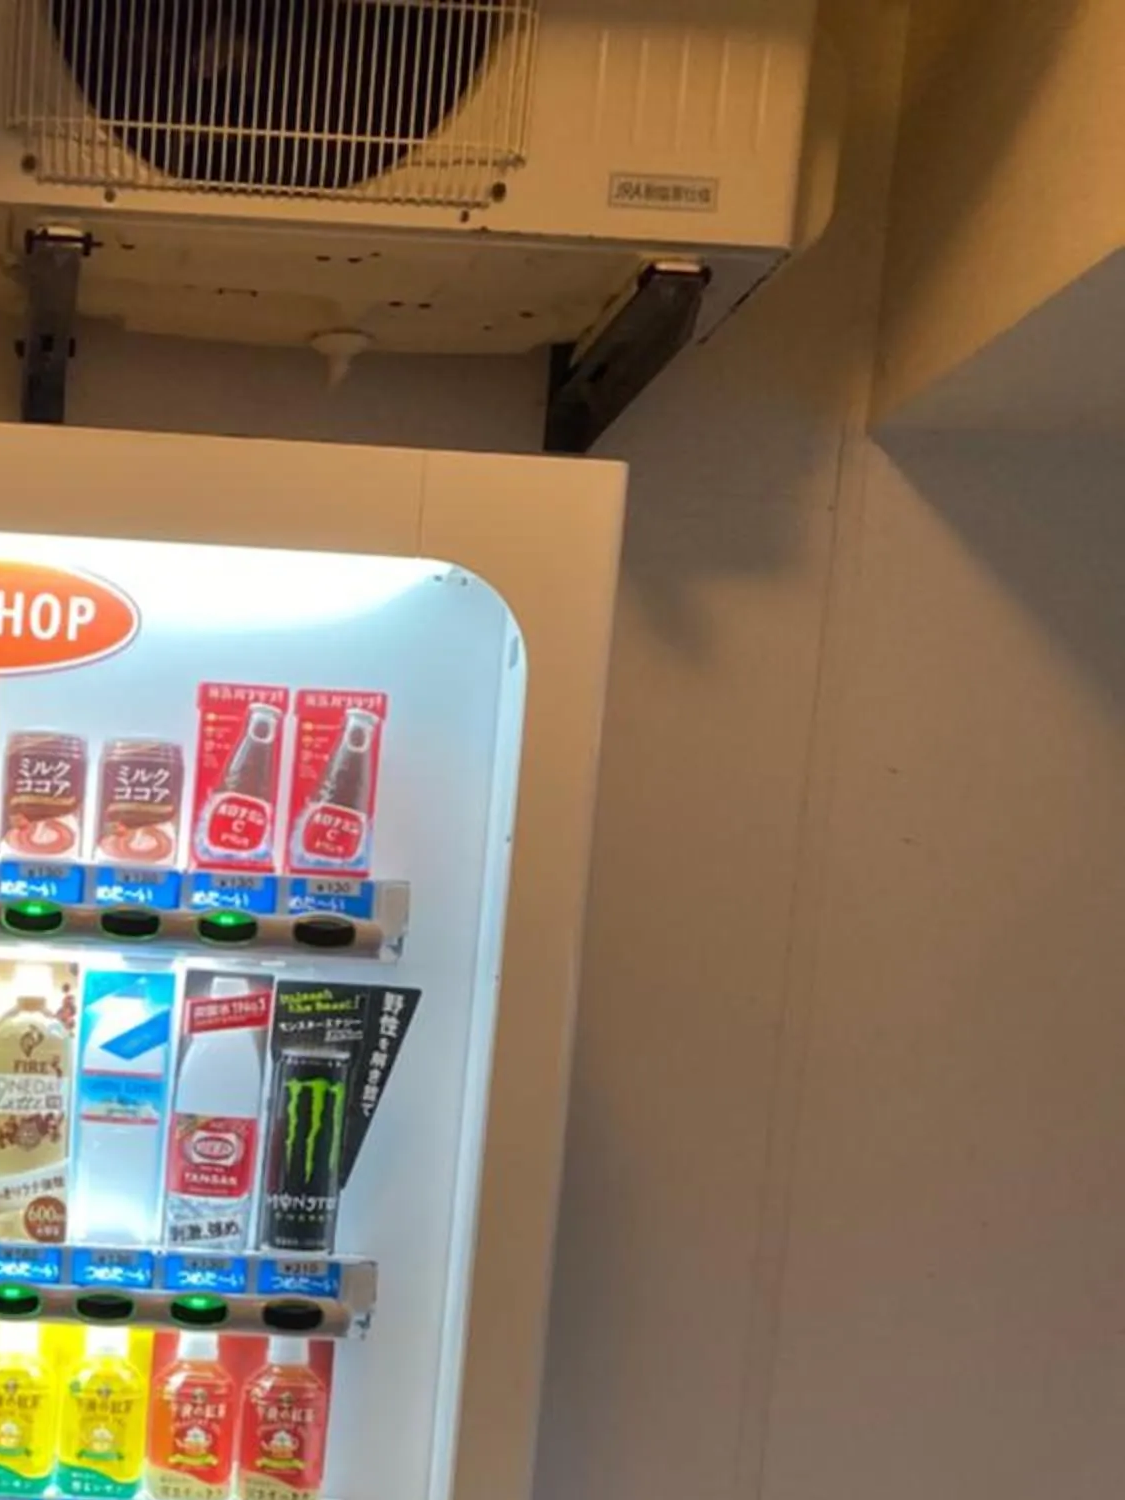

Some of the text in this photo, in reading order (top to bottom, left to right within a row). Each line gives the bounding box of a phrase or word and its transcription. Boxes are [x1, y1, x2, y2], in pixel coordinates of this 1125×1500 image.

[18, 757, 72, 778] ミルク
[116, 765, 170, 785] ミルク
[15, 778, 72, 797] ココア
[114, 785, 170, 803] ココア
